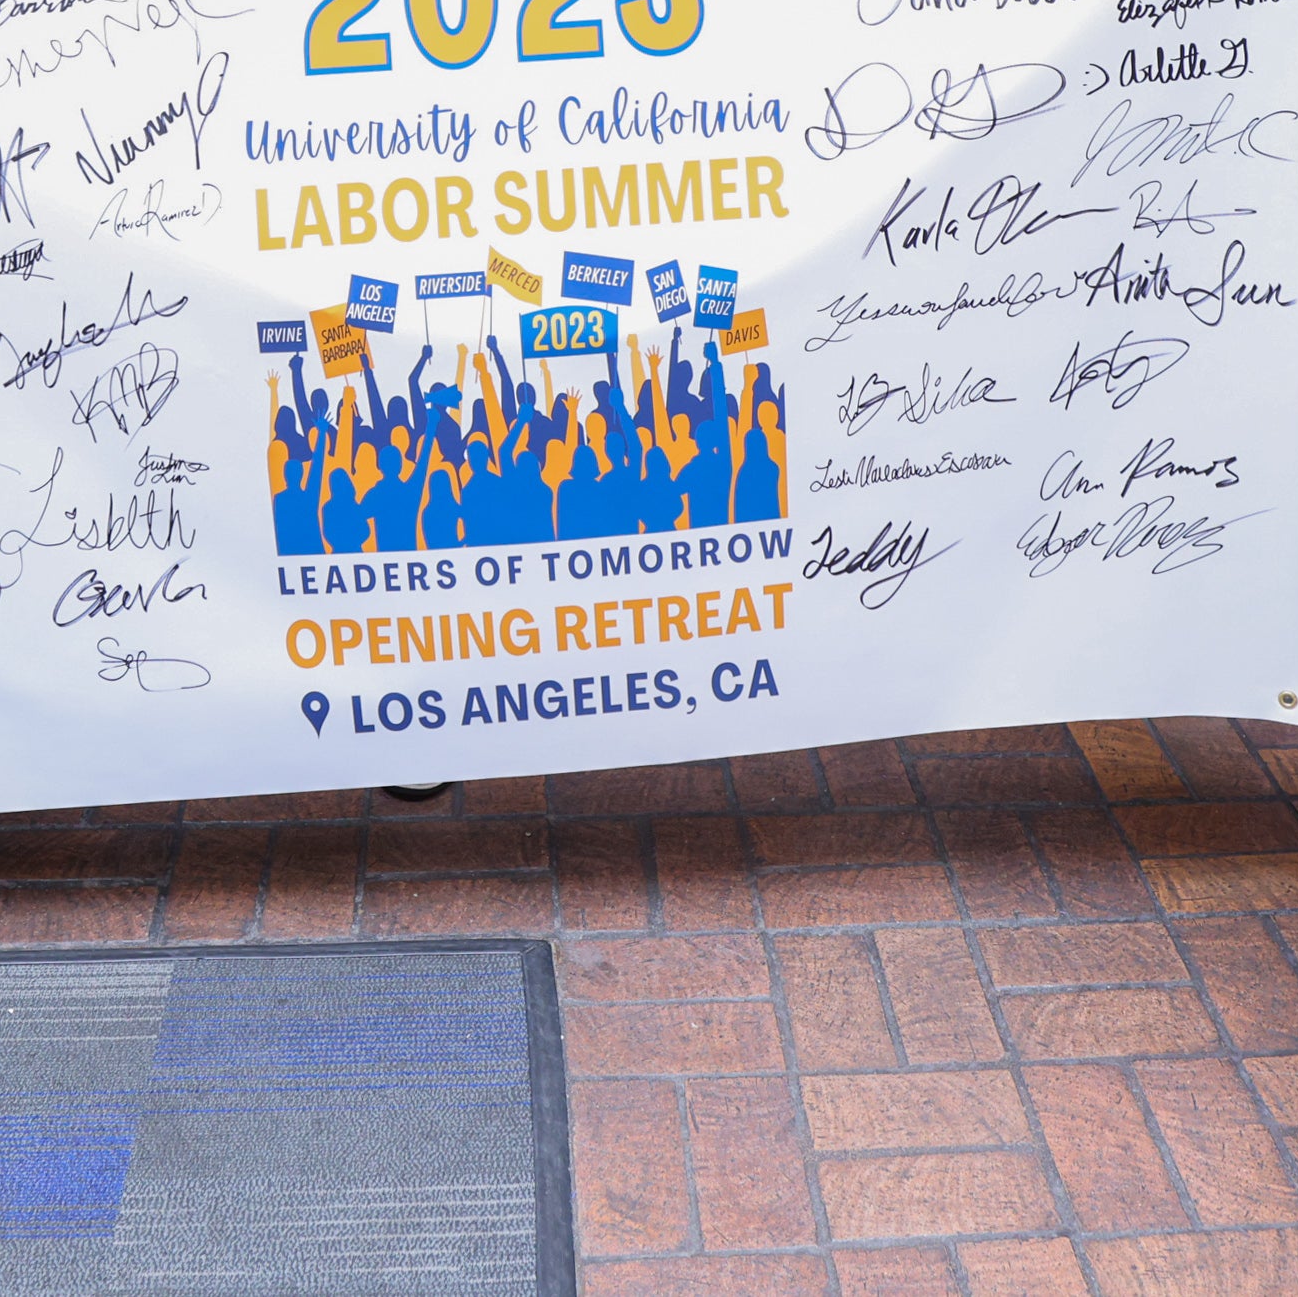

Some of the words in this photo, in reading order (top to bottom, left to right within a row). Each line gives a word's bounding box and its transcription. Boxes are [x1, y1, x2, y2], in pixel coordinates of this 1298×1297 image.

[244, 103, 477, 165] University
[493, 98, 538, 154] of
[558, 86, 791, 147] California
[254, 175, 479, 251] LABOR
[493, 156, 790, 236] SUMMER
[418, 273, 483, 298] RIVERSIDE
[488, 257, 541, 294] MERCED
[567, 263, 630, 288] BERKELEY
[652, 272, 677, 293] SAN
[696, 277, 737, 299] SANTA
[359, 283, 383, 301] LOS
[655, 287, 688, 314] DIEGO
[346, 301, 396, 325] ANGELES
[700, 298, 733, 317] CRUZ
[261, 326, 303, 345] IRVINE
[321, 323, 353, 346] SANTA
[531, 310, 605, 353] 2023
[724, 324, 761, 347] DAVIS
[321, 338, 366, 364] BARBARA
[277, 559, 458, 596] LEADERS
[474, 554, 524, 588] OF
[541, 528, 794, 582] TOMORROW
[802, 520, 964, 610] Teddy
[285, 608, 541, 670] OPENING
[554, 582, 794, 653] RETREAT
[351, 690, 447, 734] LOS
[460, 668, 698, 727] ANGELES,
[711, 658, 780, 704] CA
